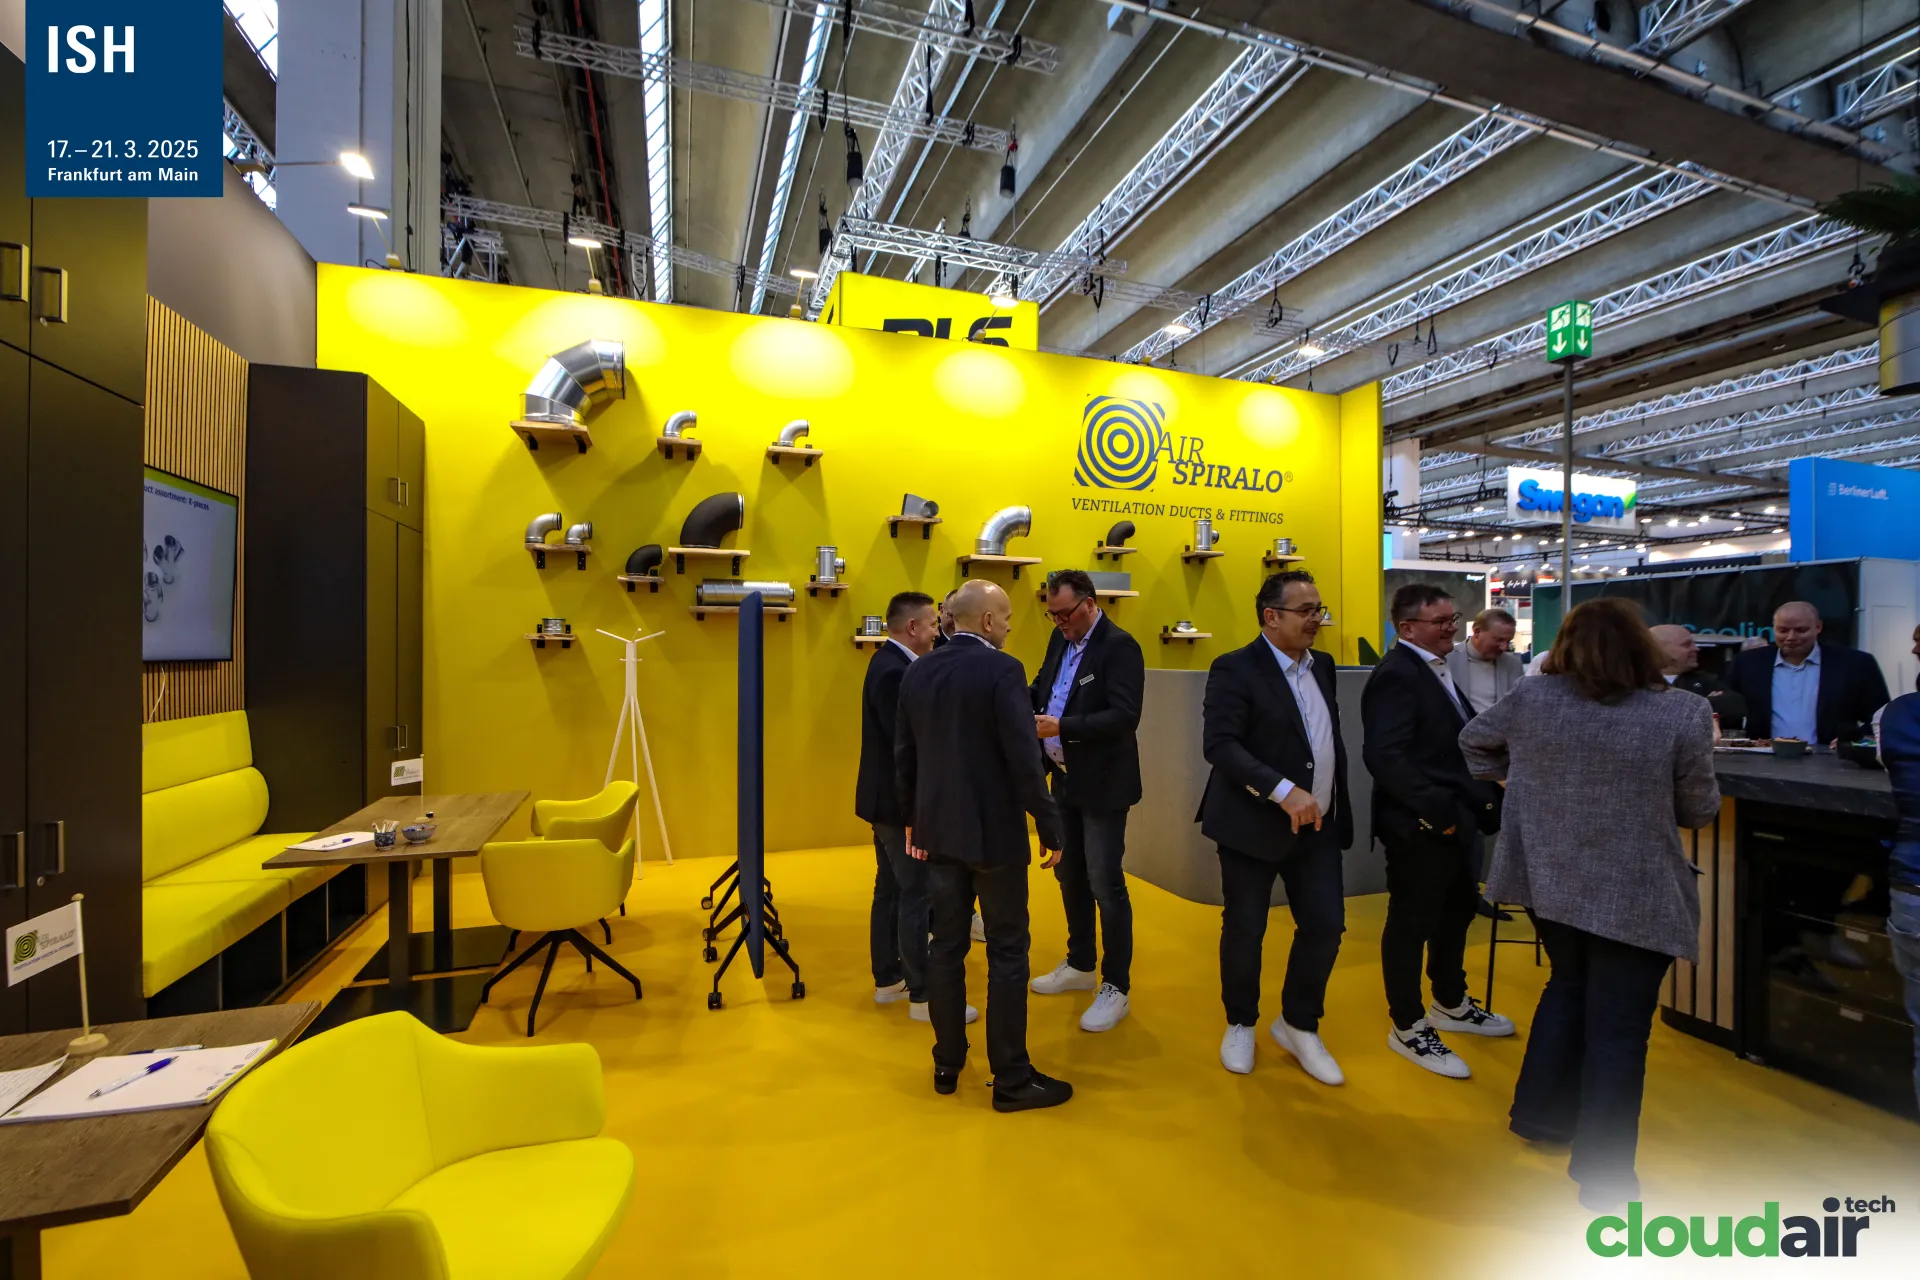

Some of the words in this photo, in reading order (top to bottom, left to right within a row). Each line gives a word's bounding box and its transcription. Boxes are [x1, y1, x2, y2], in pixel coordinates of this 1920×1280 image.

[1151, 431, 1205, 465] AIR
[1071, 497, 1166, 516] VENTILATION
[1169, 505, 1212, 520] DUCTS
[1215, 508, 1225, 520] &
[1229, 509, 1284, 525] FITTINGS
